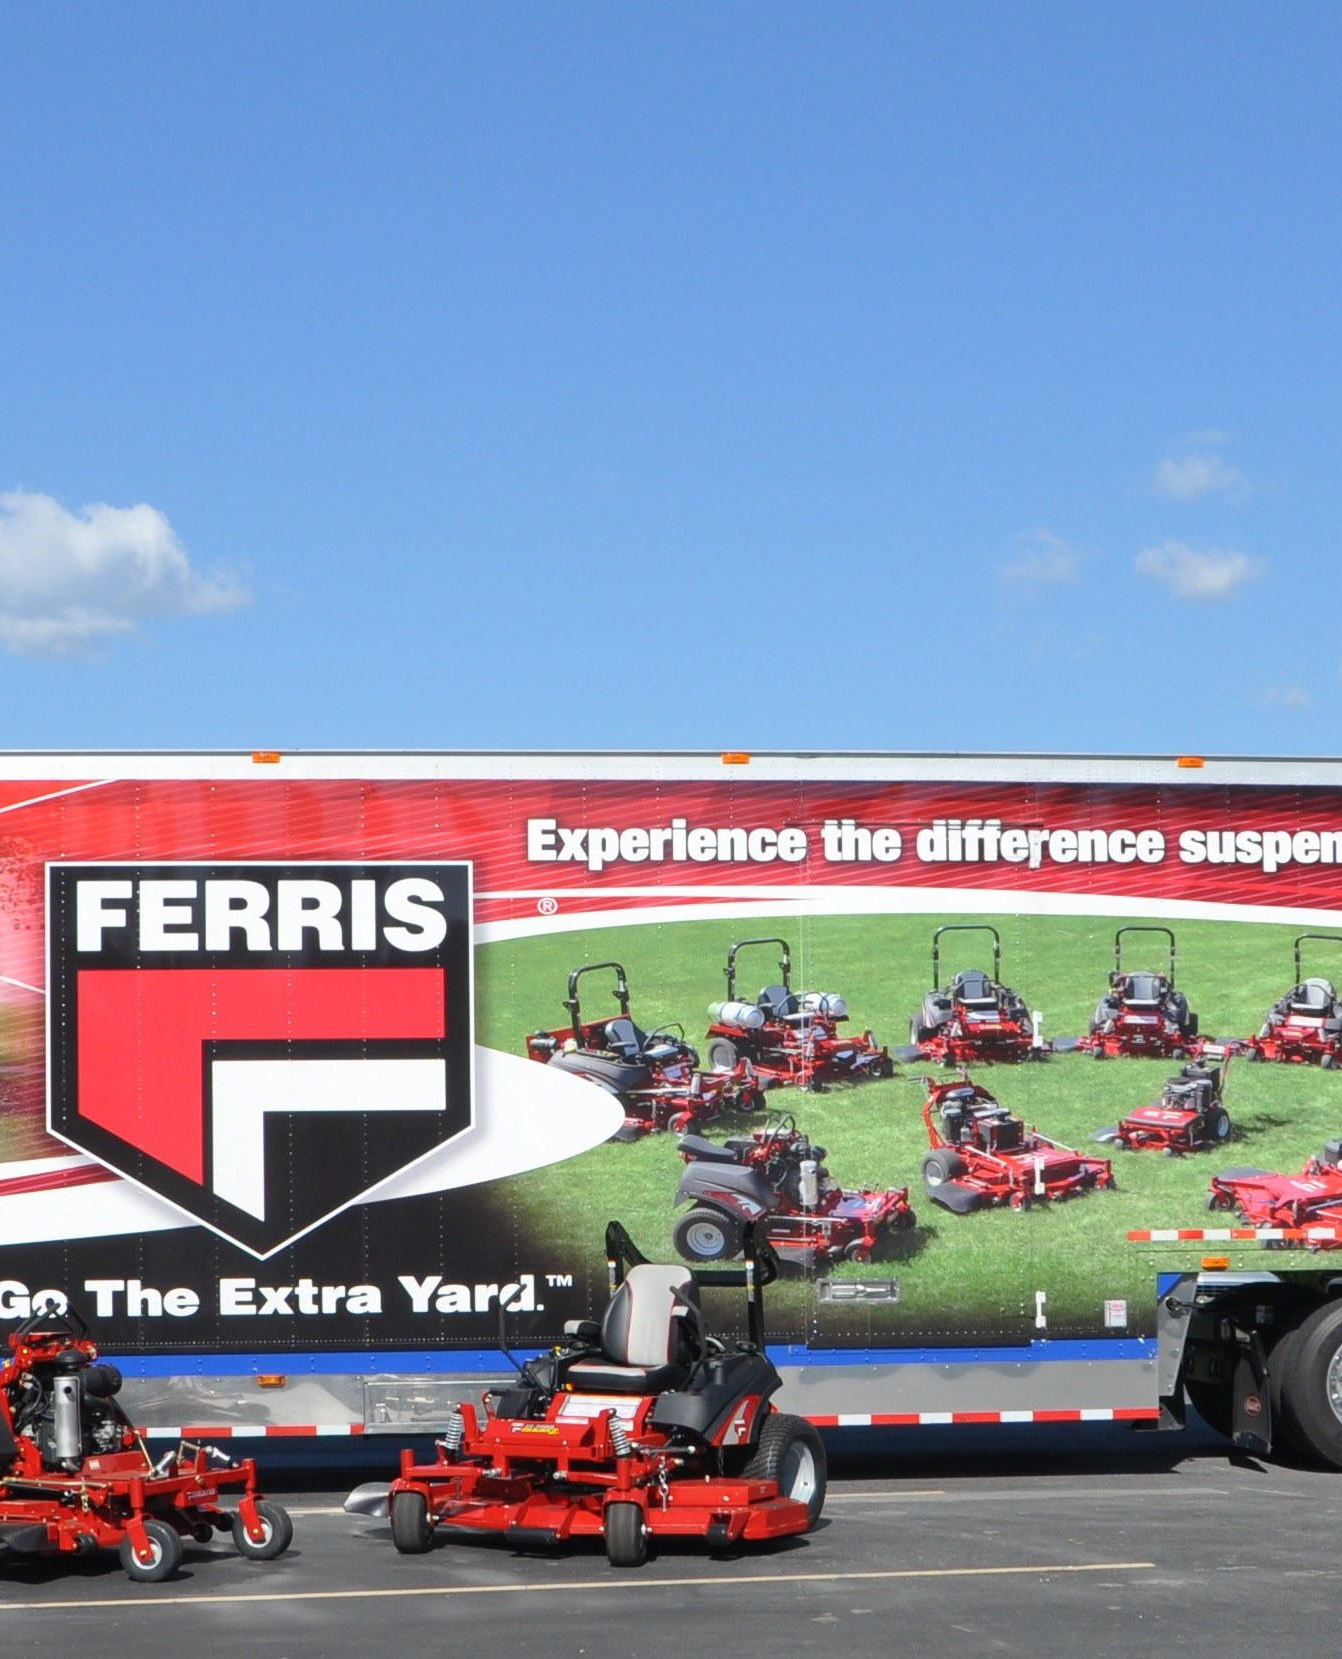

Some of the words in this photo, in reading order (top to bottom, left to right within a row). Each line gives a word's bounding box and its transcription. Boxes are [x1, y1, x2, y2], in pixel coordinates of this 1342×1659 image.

[527, 818, 808, 871] Experience
[820, 819, 902, 862] the
[915, 819, 1166, 868] difference
[76, 877, 447, 952] FERRIS
[84, 1279, 200, 1318] The
[219, 1277, 382, 1316] Extra
[397, 1274, 545, 1314] Yard.
